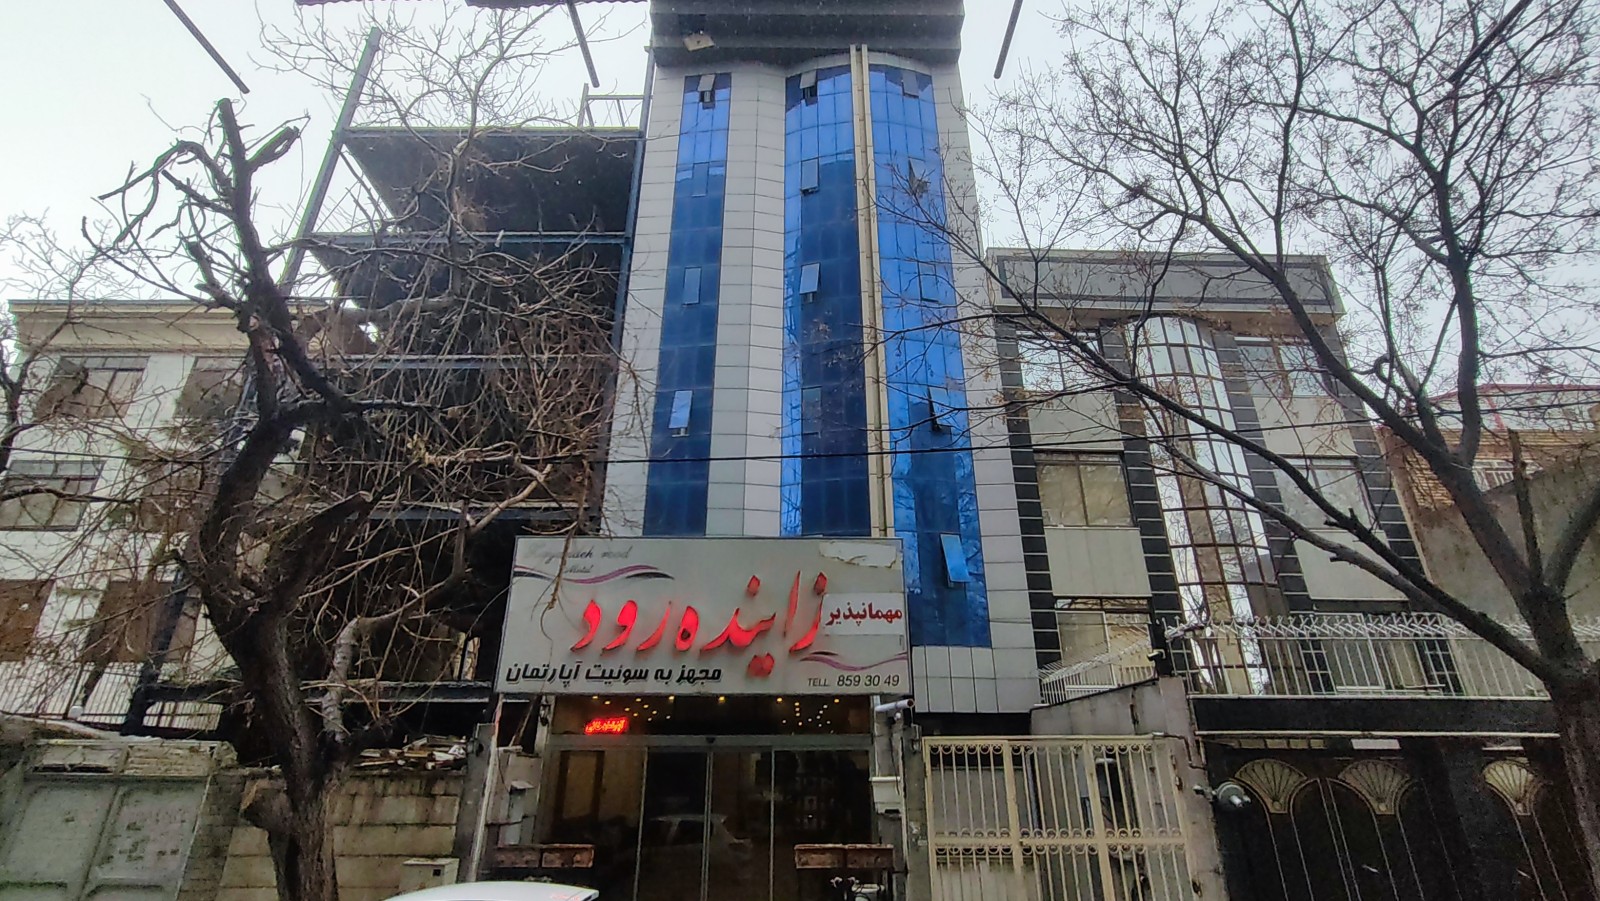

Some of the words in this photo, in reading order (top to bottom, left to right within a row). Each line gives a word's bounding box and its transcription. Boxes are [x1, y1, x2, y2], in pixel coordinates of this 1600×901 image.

[825, 602, 903, 626] مهمانپذیر
[505, 661, 583, 687] آپارتمان
[654, 667, 674, 684] به
[675, 664, 722, 684] مجهز
[837, 675, 861, 687] 859
[864, 675, 881, 687] 30
[884, 674, 900, 687] 49
